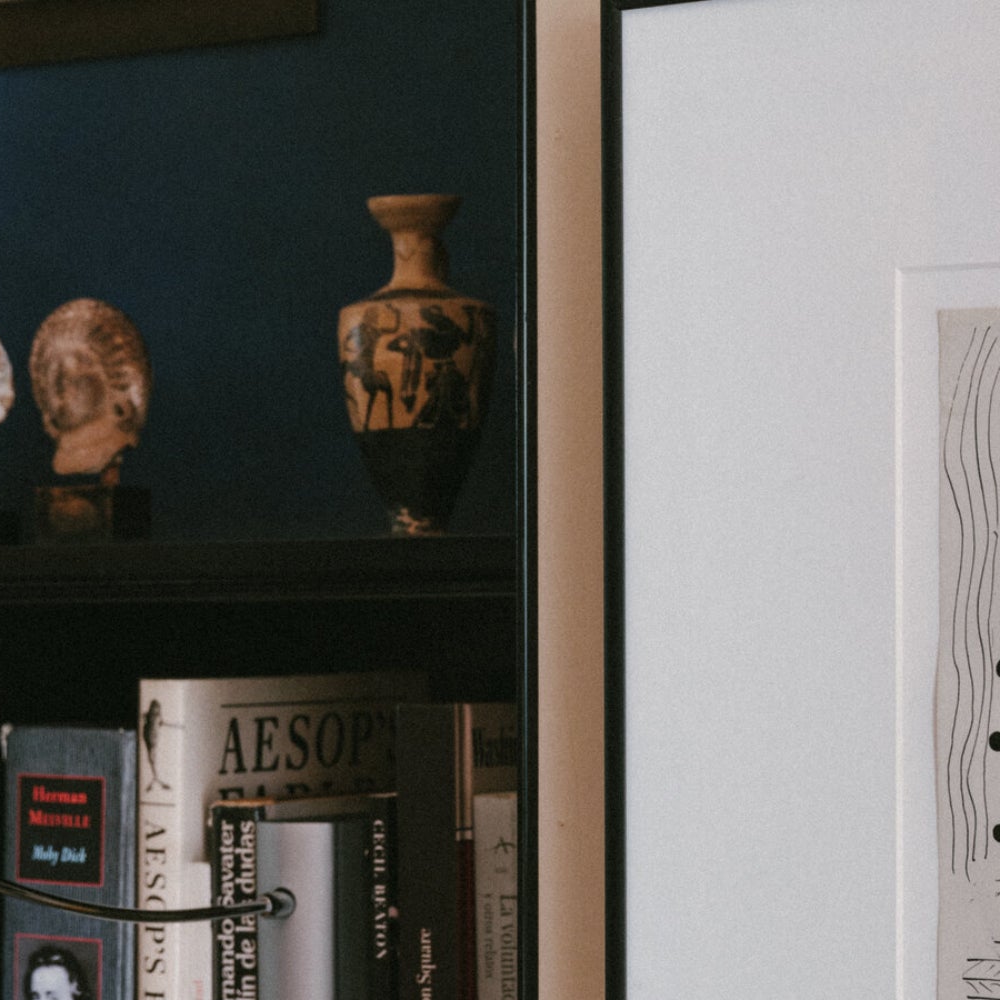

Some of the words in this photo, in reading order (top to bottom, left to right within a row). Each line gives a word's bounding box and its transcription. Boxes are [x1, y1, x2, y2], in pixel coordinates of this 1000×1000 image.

[32, 786, 87, 805] Herman
[61, 846, 88, 864] Dick
[217, 820, 236, 907] Savater
[235, 819, 258, 893] dudas
[373, 884, 388, 960] BEATON
[500, 895, 518, 917] La
[235, 934, 257, 967] de
[416, 928, 437, 985] Square
